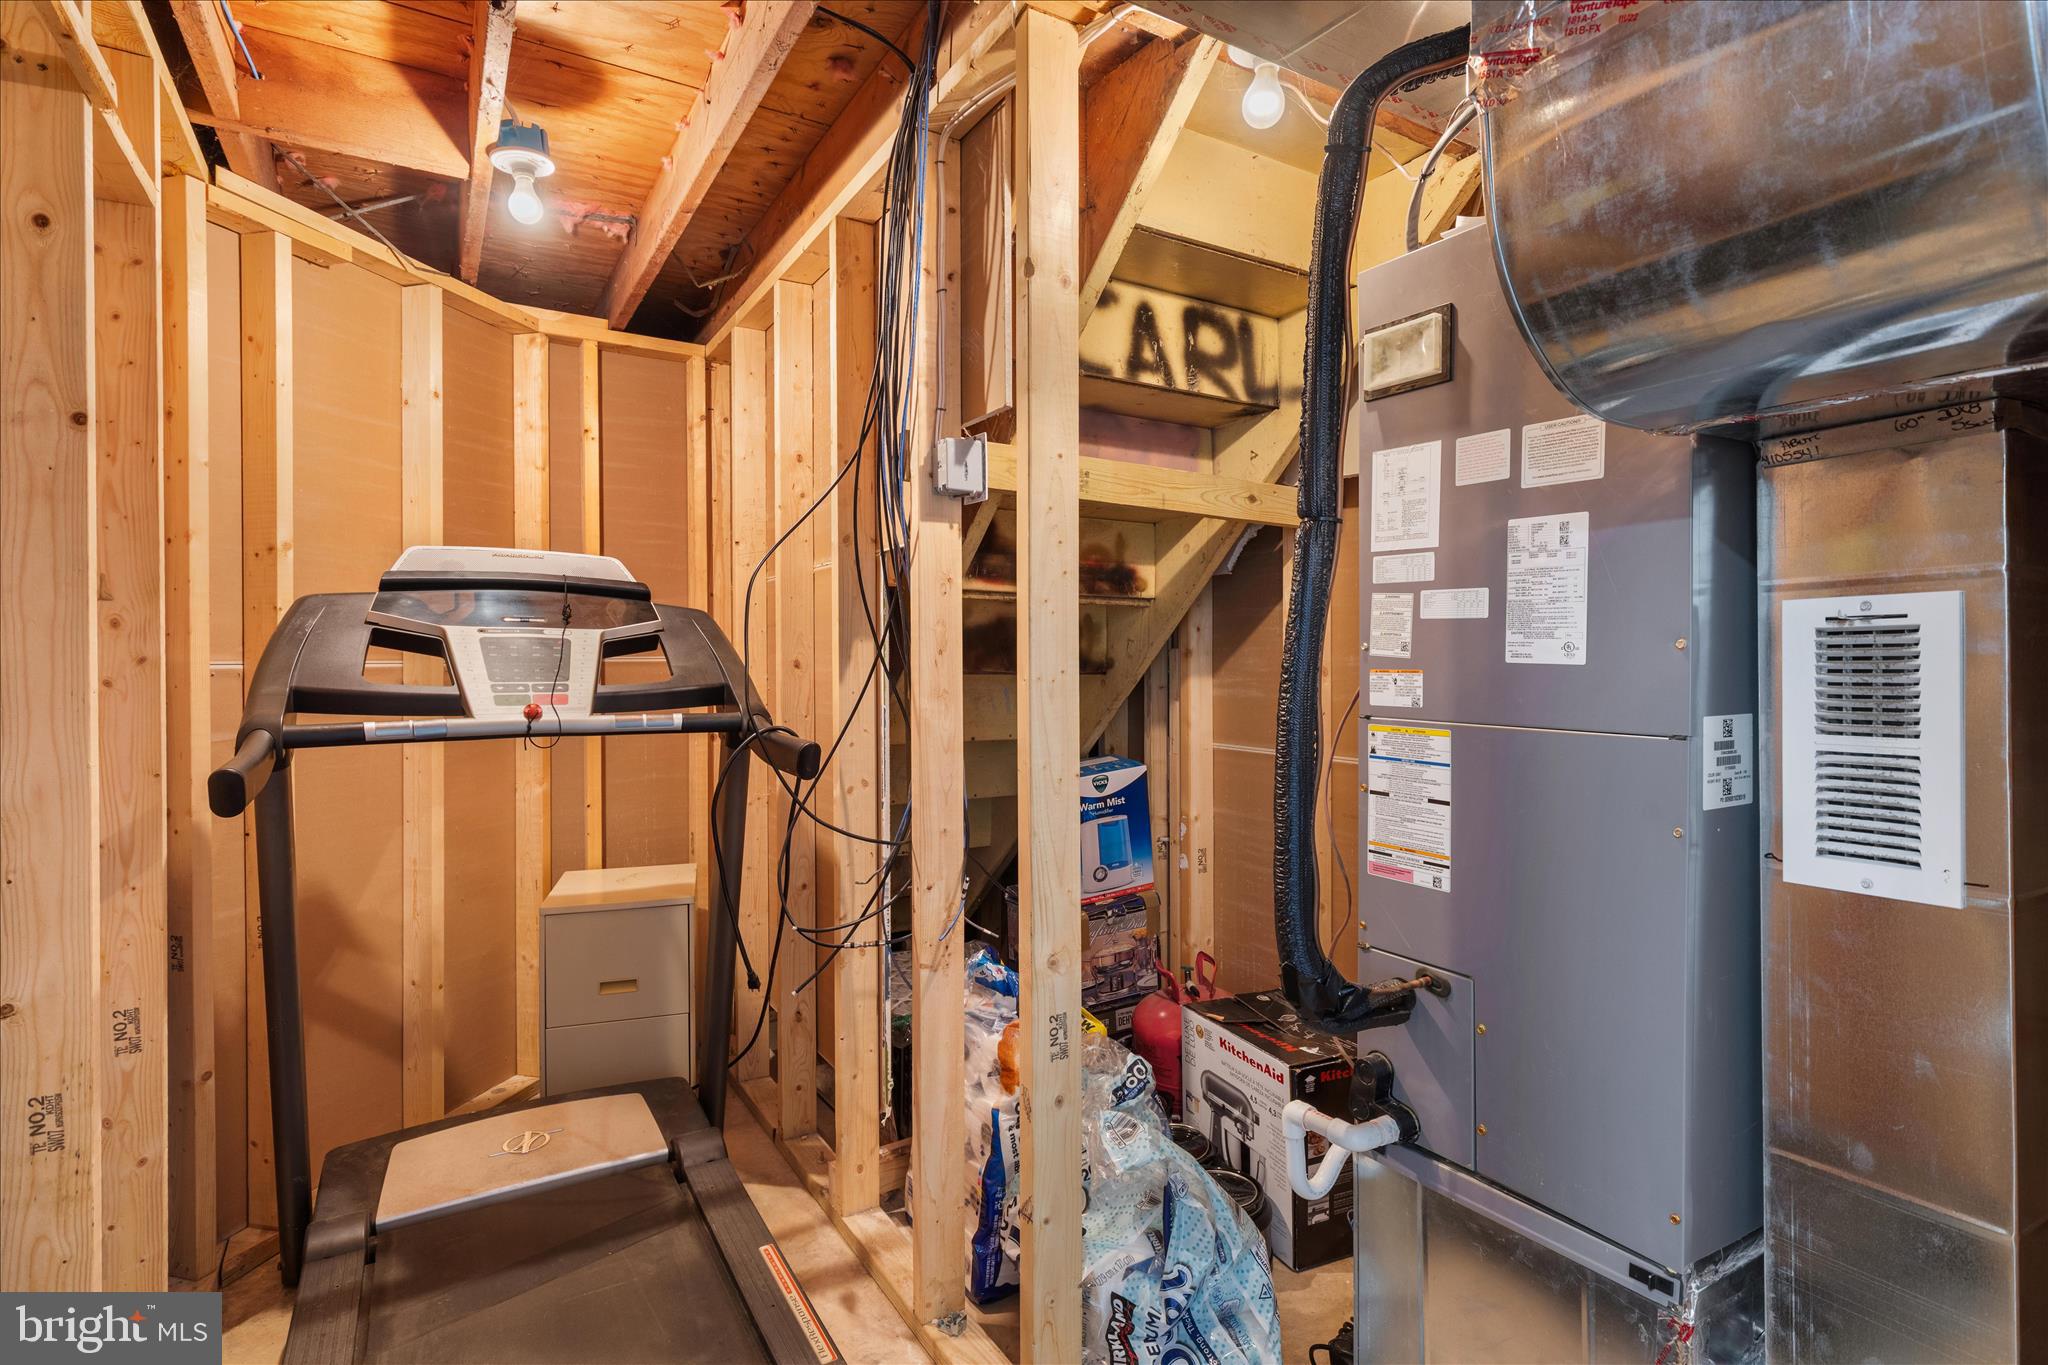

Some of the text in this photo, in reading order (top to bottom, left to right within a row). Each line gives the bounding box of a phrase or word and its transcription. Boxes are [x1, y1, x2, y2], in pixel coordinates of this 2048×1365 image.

[1092, 779, 1108, 787] VICKS
[1080, 796, 1126, 813] Warm Mist
[112, 1009, 127, 1042] NO.2
[1049, 1015, 1059, 1047] NO.2
[1219, 1036, 1285, 1085] KitchenAid
[27, 1095, 46, 1137] NO.2
[45, 1095, 54, 1115] KDHT
[47, 1130, 65, 1152] SW07
[1010, 1133, 1020, 1159] most
[789, 1295, 828, 1359] FlexResponse
[1107, 1298, 1127, 1365] IRKLAND
